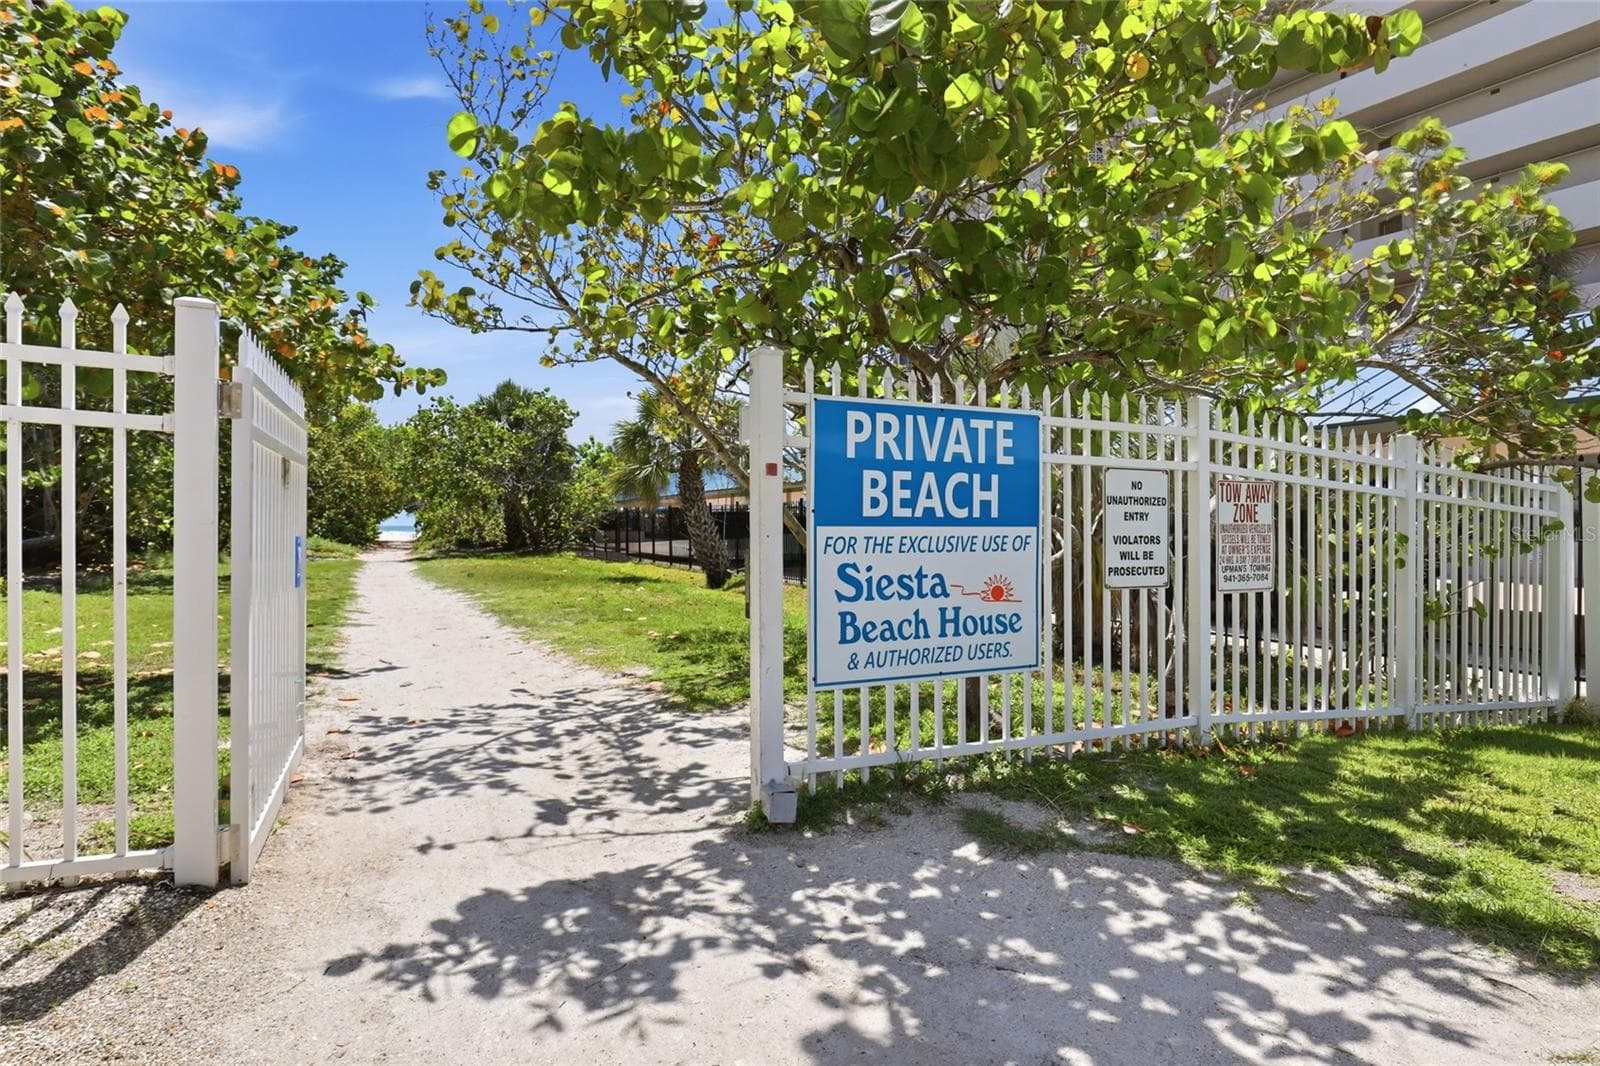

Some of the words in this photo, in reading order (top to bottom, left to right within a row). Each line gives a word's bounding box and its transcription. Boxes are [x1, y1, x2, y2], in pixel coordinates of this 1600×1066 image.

[846, 410, 1014, 465] PRIVATE
[1131, 481, 1143, 490] NO
[862, 469, 999, 519] BEACH
[1219, 483, 1241, 503] TOW
[1246, 484, 1272, 503] AWAY
[1106, 496, 1167, 506] UNAUTHORIZED
[1123, 512, 1149, 521] ENTRY
[1233, 503, 1259, 523] ZONE
[1112, 535, 1161, 545] VIOLATORS
[1240, 534, 1250, 544] WILL
[1250, 534, 1256, 544] BE
[1257, 534, 1271, 544] TOWED
[823, 536, 857, 555] FOR
[863, 536, 894, 555] THE
[898, 535, 978, 554] EXCLUSIVE
[982, 535, 1009, 552] USE
[1012, 534, 1031, 551] OF
[1221, 545, 1227, 554] AT
[1228, 545, 1249, 554] OWNER'S
[1251, 545, 1271, 554] EXPENSE
[1120, 551, 1140, 560] WILL
[1143, 551, 1154, 560] BE
[1108, 566, 1165, 576] PROSECUTED
[1221, 564, 1247, 573] UPMAN'S
[1250, 564, 1271, 573] TOWING
[834, 561, 950, 603] Siesta
[1223, 573, 1269, 583] 941-365-7084
[838, 607, 930, 645] Beach
[937, 606, 1023, 639] House
[847, 652, 860, 671] &
[864, 644, 963, 670] AUTHORIZED
[967, 641, 1013, 661] USERS.
